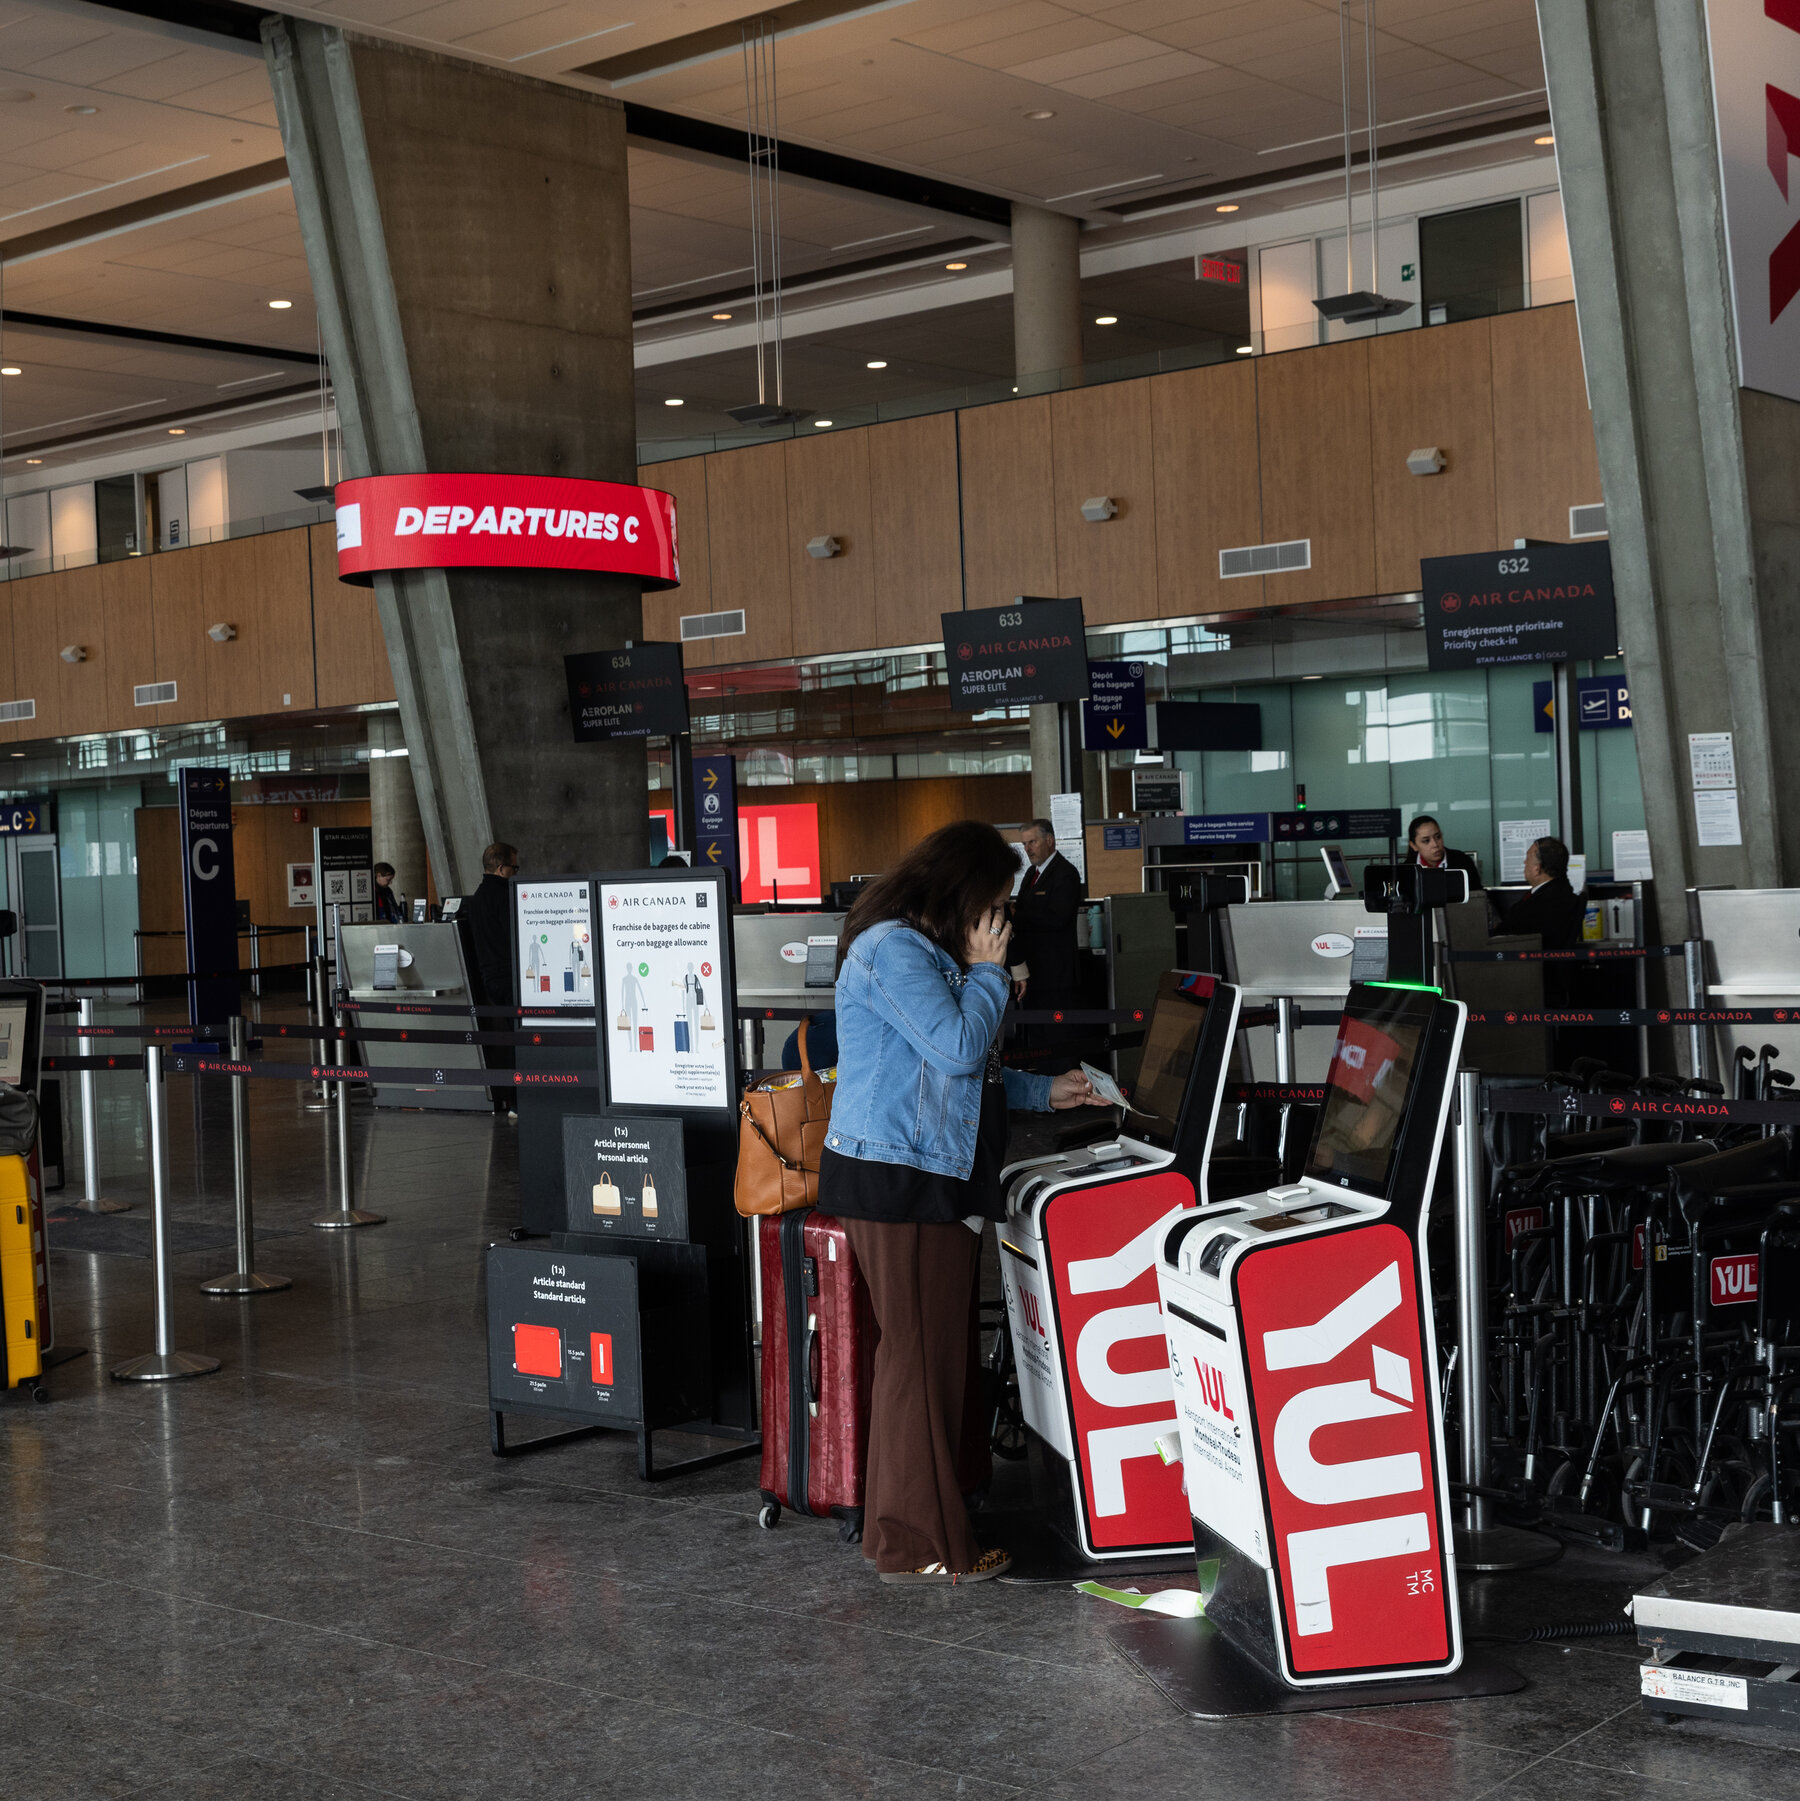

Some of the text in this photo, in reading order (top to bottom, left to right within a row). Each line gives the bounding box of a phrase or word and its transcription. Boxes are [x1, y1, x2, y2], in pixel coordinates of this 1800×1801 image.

[394, 506, 639, 543] DEPARTURES C
[1498, 557, 1529, 574] 632
[1469, 584, 1596, 607] AIR CANADA
[1000, 612, 1023, 627] 633
[1442, 620, 1563, 640] Enregistrement prioritaire
[978, 635, 1072, 656] AIR CANADA
[1444, 635, 1518, 652] Priority check-in
[611, 656, 631, 669] 634
[1476, 656, 1495, 664] STAR
[1497, 652, 1534, 662] ALLIANCE
[961, 667, 1022, 683] AEROPLAN
[1092, 671, 1113, 684] Dépôt
[596, 677, 672, 693] AIR CANADA
[962, 682, 1007, 695] SUPER ELITE
[1092, 681, 1135, 694] des bagages
[1093, 694, 1123, 707] Baggage
[582, 703, 632, 718] AEROPLAN
[1093, 703, 1123, 714] drop-off
[583, 716, 620, 728] SUPER ELITE
[12, 811, 23, 831] C
[189, 808, 218, 821] Départs
[190, 821, 230, 832] Departures
[192, 838, 220, 880] C
[544, 891, 573, 899] CANADA
[622, 896, 686, 907] AIR CANADA
[612, 921, 711, 933] Franchise de bagages de cabine
[616, 937, 708, 949] Carry-on baggage allowance
[1543, 951, 1576, 959] CANADA
[1613, 949, 1647, 957] CANADA
[1521, 1013, 1594, 1022] AIR CANADA
[1675, 1012, 1753, 1021] AIR CANADA
[208, 1061, 252, 1073] AIR CANADA
[322, 1070, 369, 1079] AIR CANADA
[525, 1075, 579, 1083] AIR CANADA
[1254, 1088, 1325, 1098] AIR CANAD
[1632, 1101, 1729, 1115] AIR CANADA
[614, 1126, 628, 1138] (1x)
[594, 1139, 650, 1151] Article personnel
[597, 1152, 648, 1164] Personal article
[551, 1264, 566, 1277] (1x)
[533, 1276, 585, 1290] Article standard
[1715, 1263, 1757, 1296] YUL
[533, 1290, 586, 1304] Standard article
[1019, 1285, 1045, 1338] YUL
[1068, 1202, 1183, 1518] YUL
[1193, 1355, 1234, 1422] YUL
[1263, 1259, 1431, 1638] YUL
[1406, 1571, 1420, 1596] TM
[1419, 1568, 1435, 1594] MC
[1672, 1672, 1706, 1684] BALANCE
